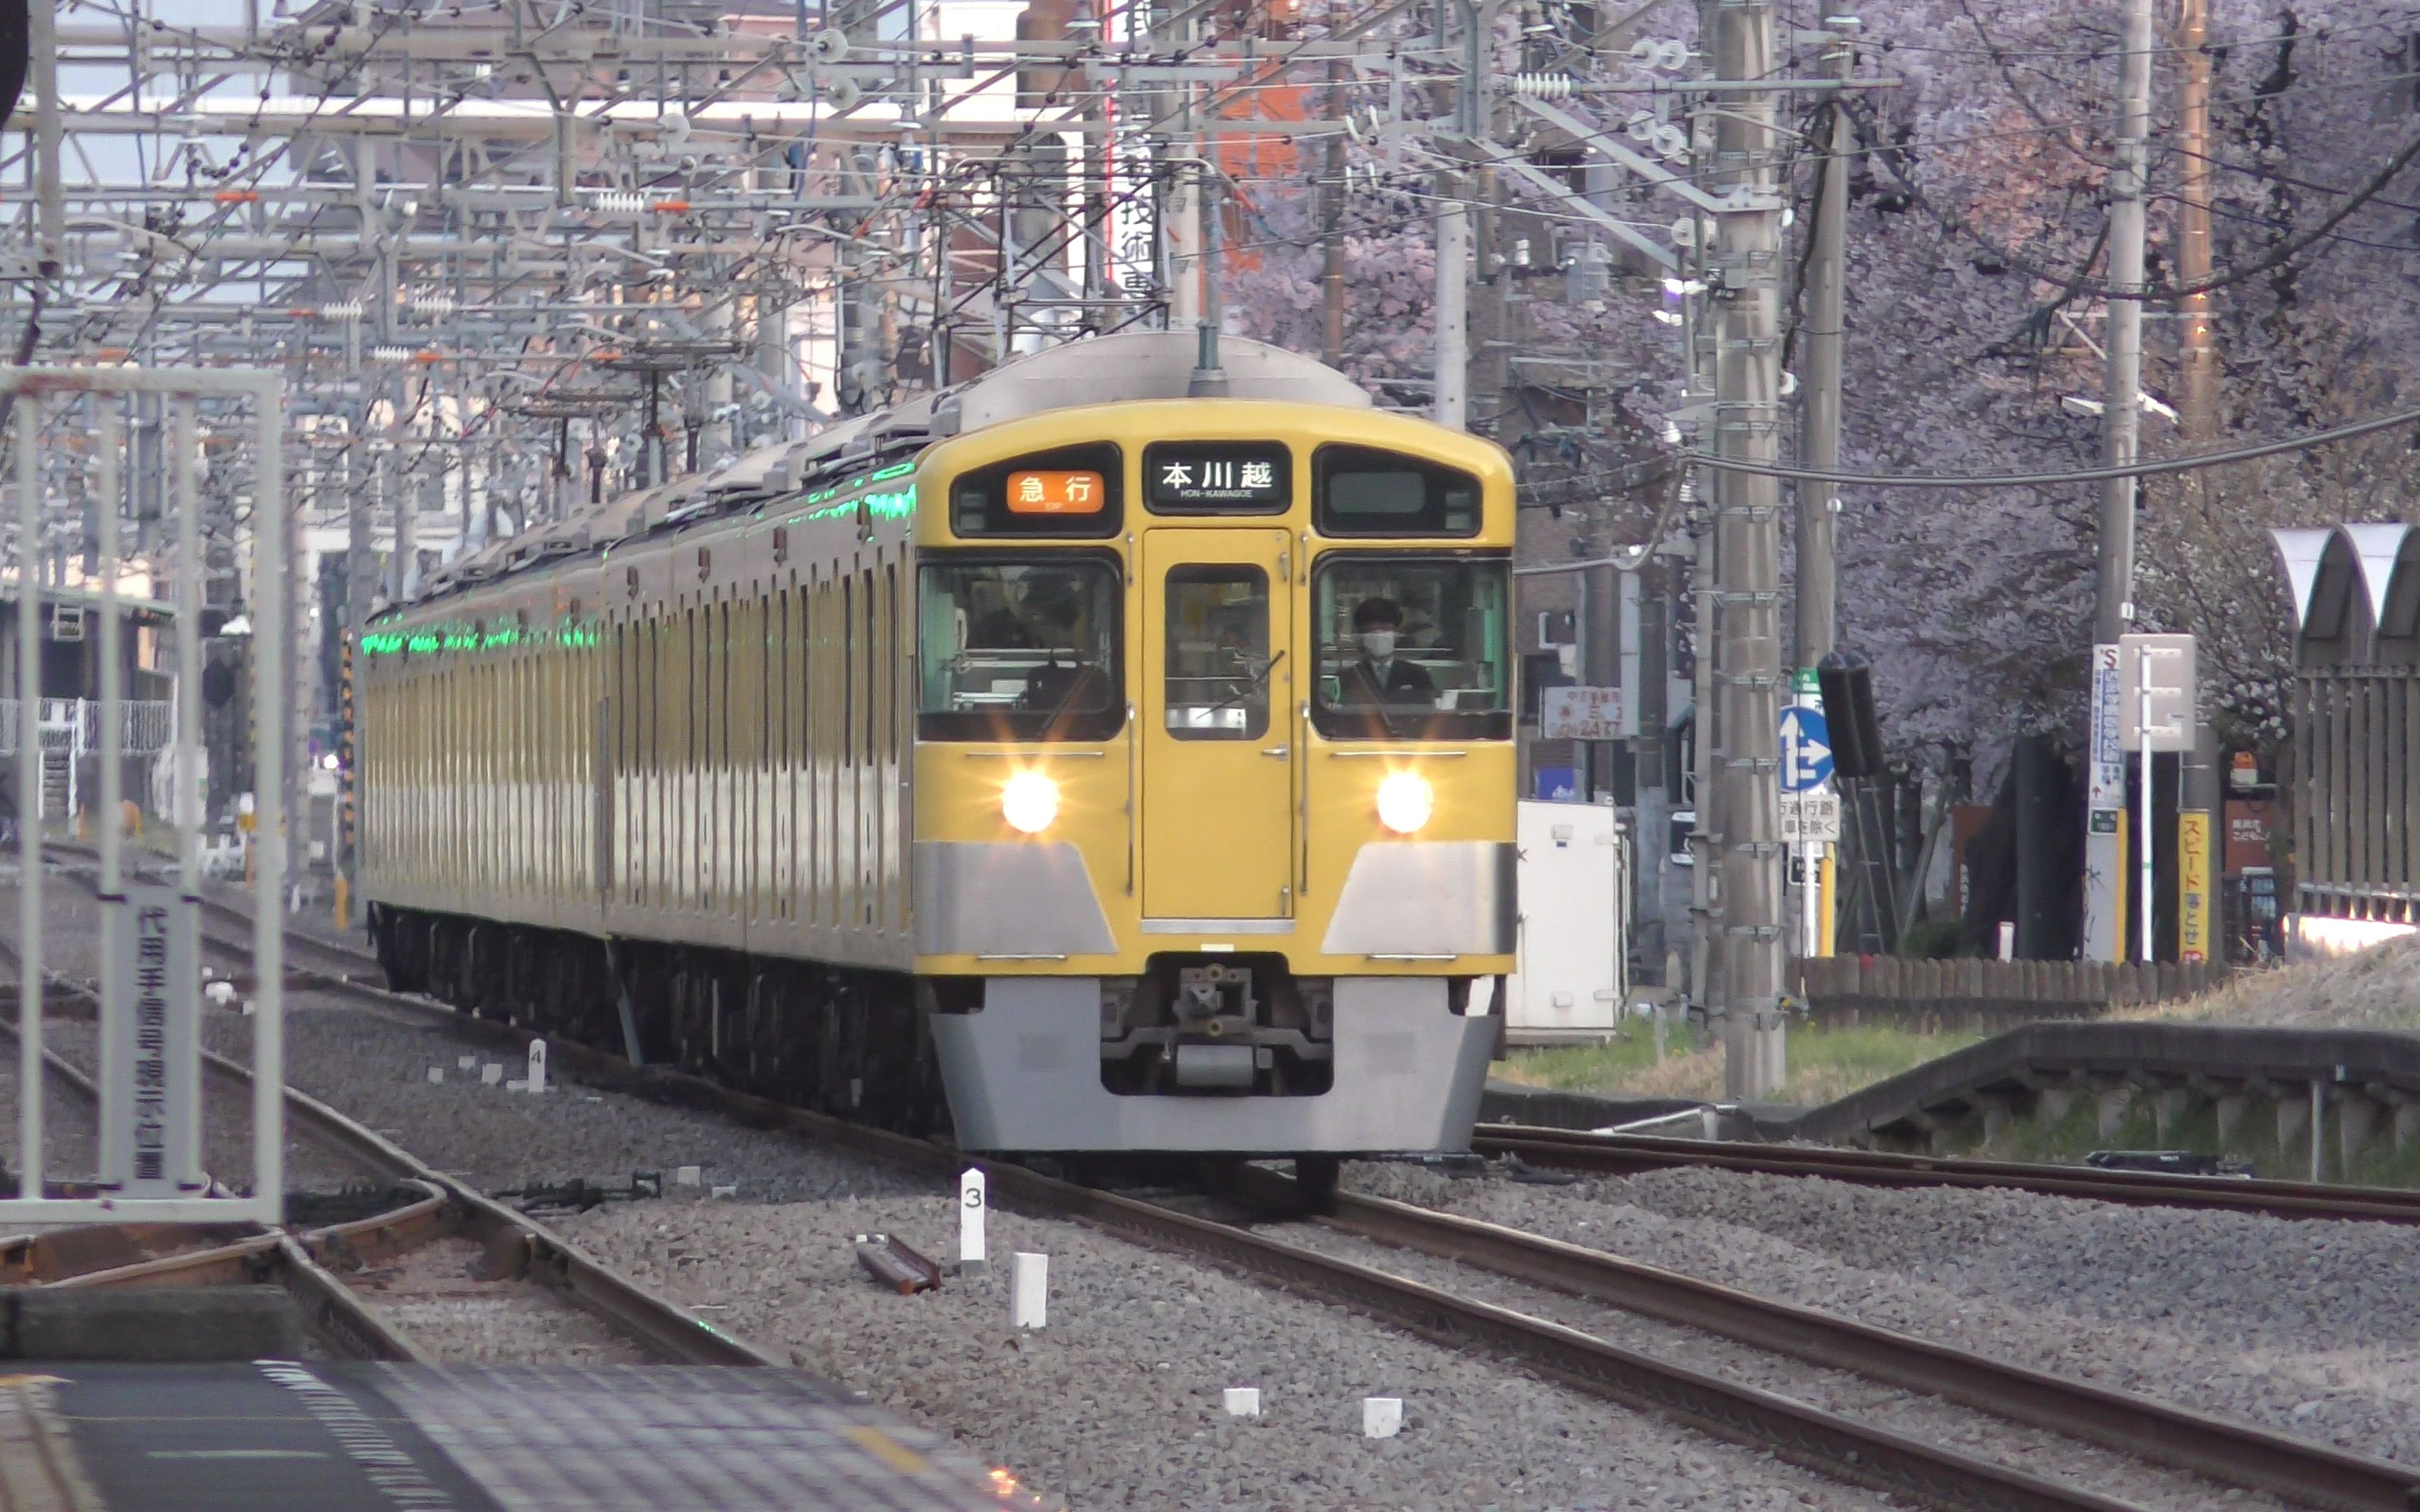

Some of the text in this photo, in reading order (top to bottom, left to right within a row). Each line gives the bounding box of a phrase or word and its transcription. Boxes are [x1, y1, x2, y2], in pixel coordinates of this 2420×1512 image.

[1162, 461, 1273, 489] 本川越
[1020, 476, 1092, 503] 急行
[1181, 489, 1253, 498] HON-KAWAGOE
[964, 1188, 982, 1208] 3
